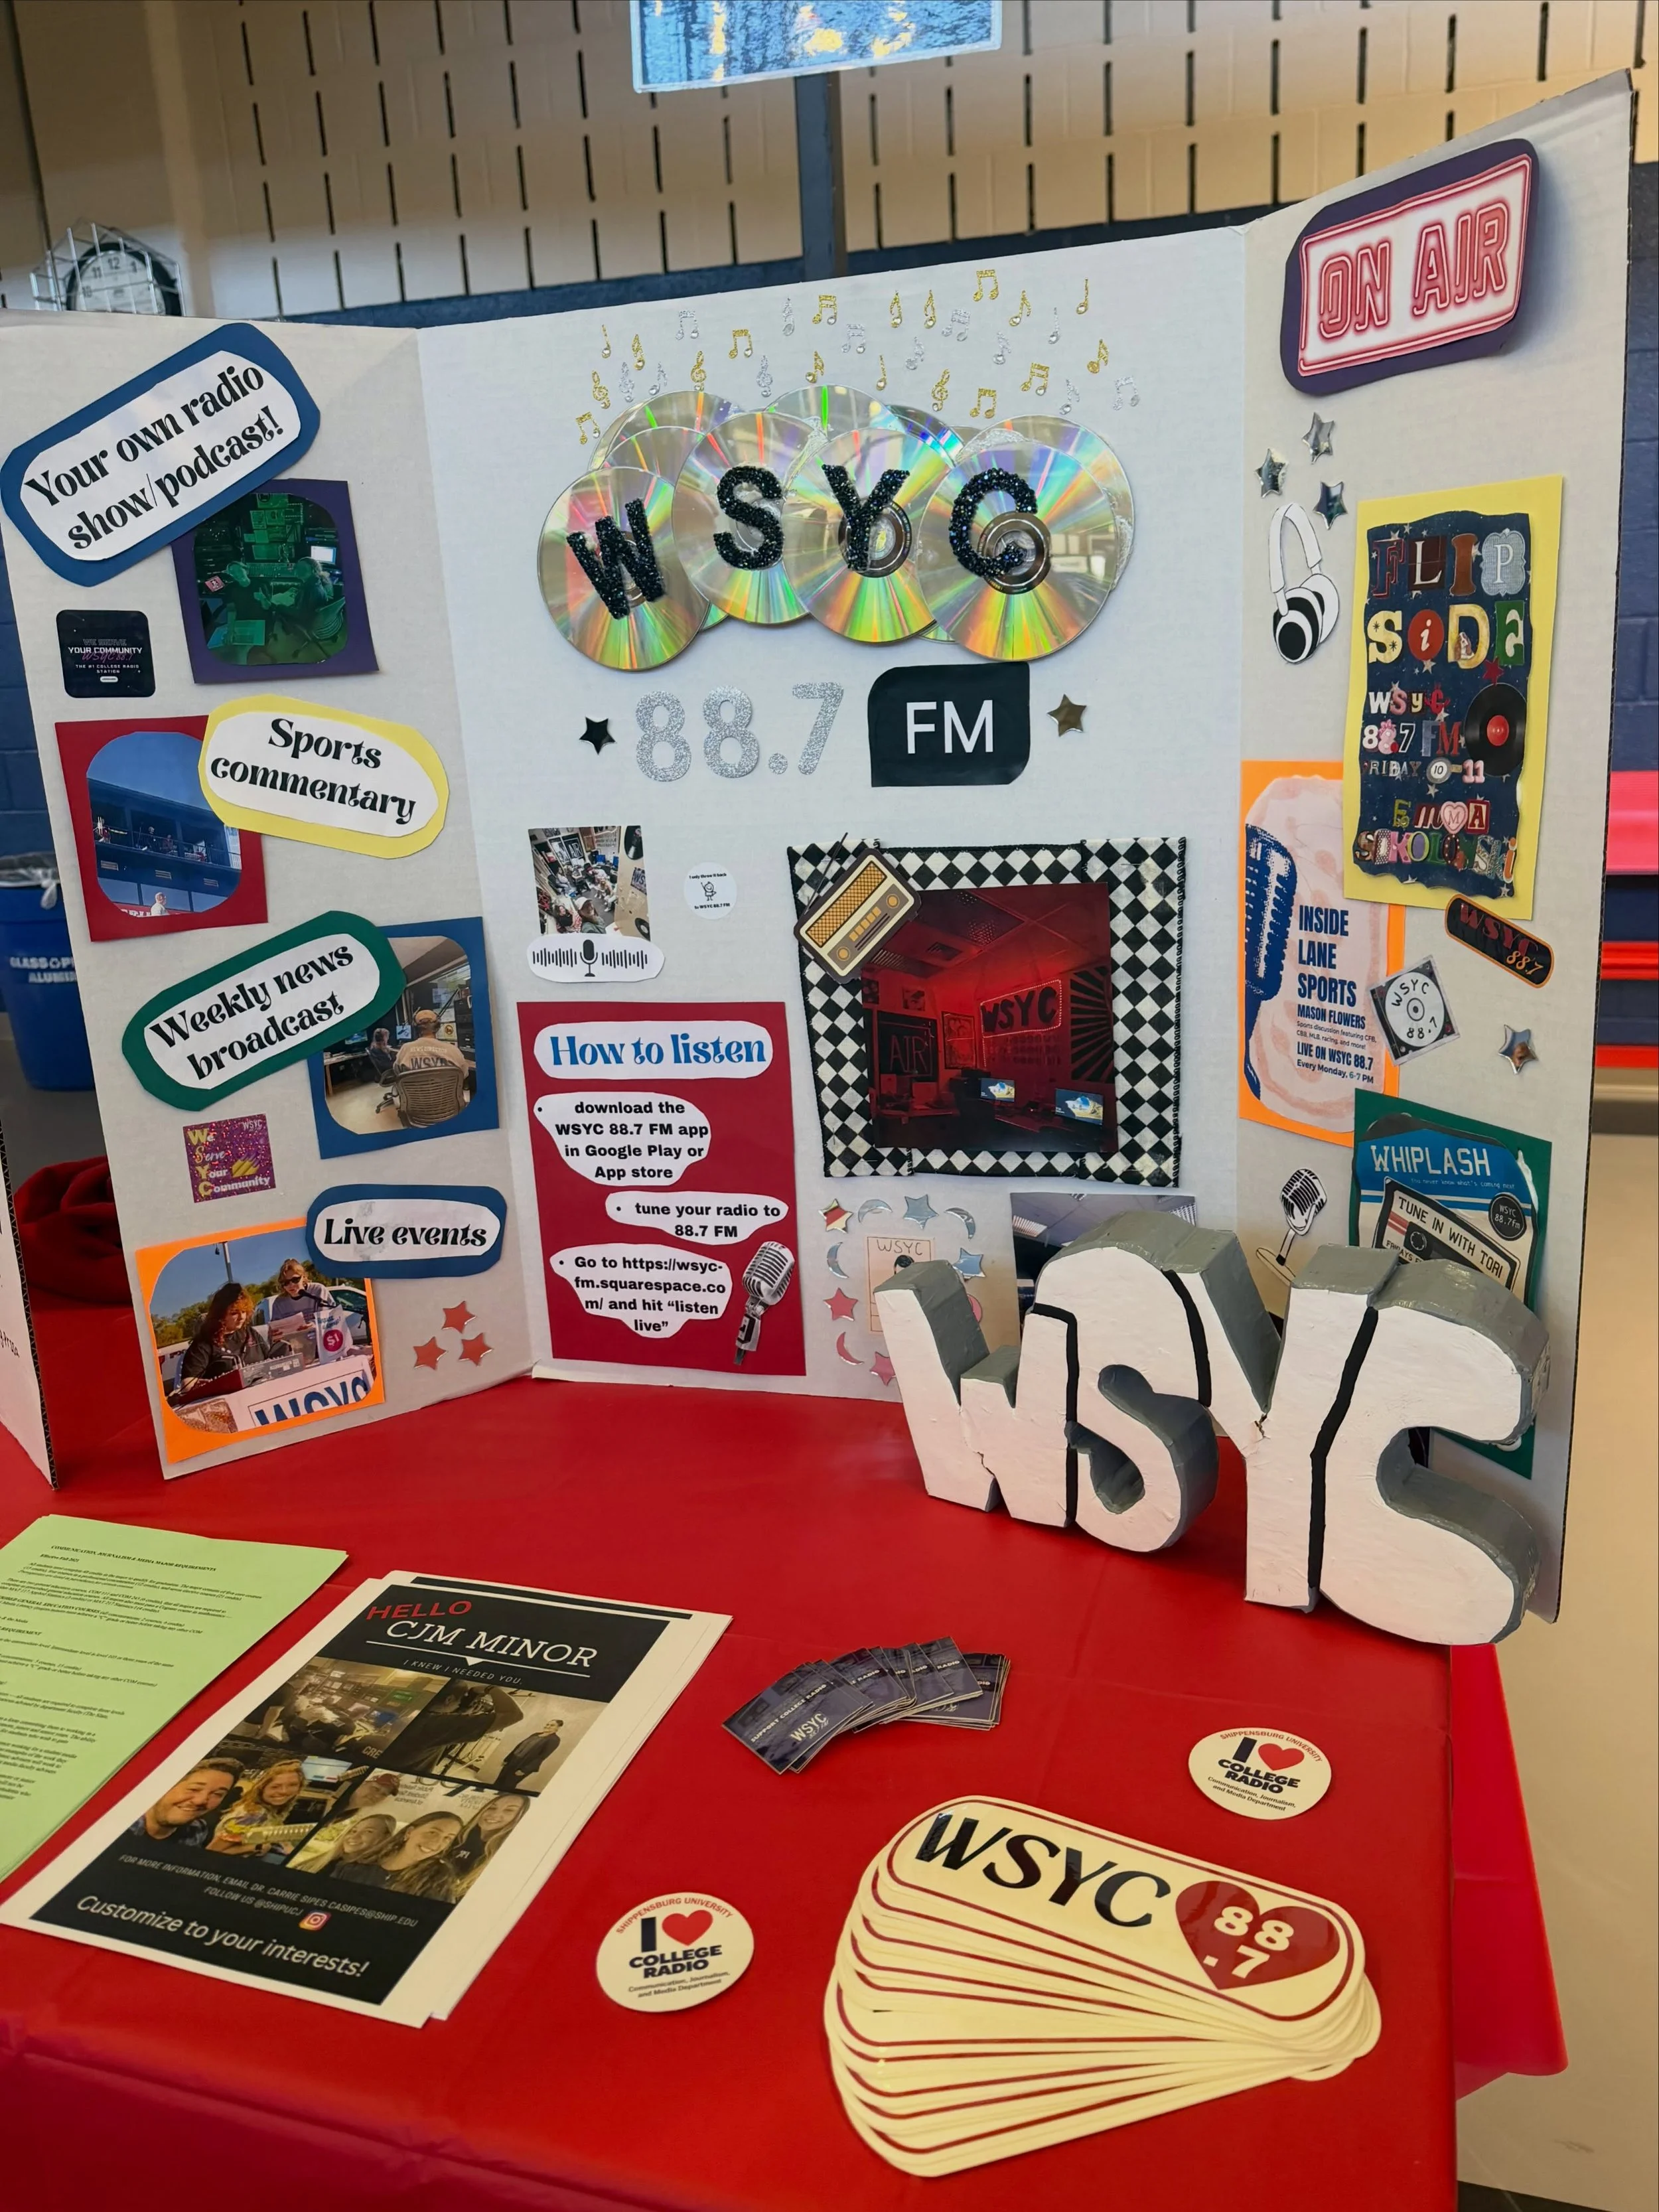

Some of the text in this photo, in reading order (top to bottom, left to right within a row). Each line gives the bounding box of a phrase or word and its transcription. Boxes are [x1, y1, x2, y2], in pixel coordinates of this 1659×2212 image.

[108, 258, 120, 269] 12
[1318, 202, 1509, 340] ON AIR
[25, 365, 264, 507] Your own radio
[68, 405, 284, 550] show/podcast!
[1372, 531, 1520, 599] FLIP
[268, 718, 382, 769] Sports
[634, 682, 995, 782] 88.7 FM
[210, 757, 416, 824] commentary
[1299, 905, 1348, 936] INSIDE
[1459, 903, 1538, 956] WSYC
[1299, 939, 1336, 969] LANE
[1506, 950, 1544, 976] 88.7
[149, 946, 354, 1049] Weekly news
[1297, 972, 1356, 1007] SPORTS
[1391, 979, 1429, 1007] WSYC
[981, 986, 1056, 1033] WSYC
[1297, 1004, 1366, 1029] MASON FLOWERS
[186, 992, 344, 1080] broadcast
[1314, 1024, 1340, 1035] discussion
[1340, 1029, 1364, 1041] featuring
[1406, 1016, 1437, 1039] 88.7
[550, 1033, 766, 1066] How to listen
[1297, 1041, 1374, 1070] LIVE ON WSYC 88.7
[1297, 1059, 1374, 1083] Every Monday, 6-7 PM
[575, 1101, 685, 1114] download the
[187, 1128, 215, 1145] We
[242, 1120, 262, 1130] WSYC
[555, 1124, 709, 1139] WSYC 88.7 FM app
[195, 1146, 225, 1163] Serve
[564, 1144, 703, 1160] in Google Play or
[1370, 1145, 1490, 1176] WHIPLASH
[195, 1164, 228, 1179] Your
[595, 1166, 673, 1181] App store
[198, 1177, 270, 1197] Community
[635, 1204, 780, 1220] tune your radio to
[1494, 1213, 1520, 1229] 88.7fm
[1499, 1205, 1516, 1217] WSYC
[323, 1218, 487, 1248] Live events
[675, 1225, 737, 1237] 88.7 FM
[1399, 1196, 1503, 1278] TUNE IN WITH TORI
[876, 1239, 923, 1256] WSYC
[575, 1256, 723, 1274] Go to https://wsyc-
[575, 1277, 725, 1294] fm.squarespace.co
[585, 1297, 603, 1311] m/
[609, 1299, 638, 1311] and
[642, 1299, 664, 1311] hit
[327, 1335, 340, 1346] $1
[873, 1211, 1550, 1645] WSYC
[366, 1600, 472, 1620] HELLO
[386, 1620, 598, 1667] CJM MINOR
[411, 1660, 522, 1684] KNEW NEEDED YOU.
[857, 1669, 881, 1682] RADIO
[937, 1660, 960, 1669] RADIO
[751, 1684, 827, 1743] SUPPORT COLLEGE RADIO
[790, 1713, 827, 1741] WSYC
[1220, 1730, 1323, 1762] SHIPPENSBURG UNIVERSITY
[1232, 1736, 1258, 1763] I
[1218, 1759, 1301, 1788] COLLEGE
[1224, 1770, 1283, 1794] RADIO
[1208, 1776, 1296, 1808] Communication, Journalism,
[1226, 1789, 1246, 1800] Media
[1247, 1795, 1286, 1811] Department
[914, 1811, 1171, 1929] WSYC
[119, 1854, 138, 1863] FOR
[137, 1858, 165, 1870] MORE
[222, 1877, 250, 1889] EMAIL
[250, 1883, 265, 1893] DR.
[267, 1887, 300, 1901] CARRIE
[301, 1895, 328, 1907] SIPES
[328, 1901, 419, 1927] CASIPES@SHIP.EDU
[204, 1886, 304, 1916] FOLLOW US @SHIPUCJ
[616, 1897, 733, 1934] SHIPPENSBURG UNIVERSITY
[76, 1895, 370, 1977] Customize to your interests!
[641, 1917, 656, 1953] I
[629, 1945, 723, 1968] COLLEGE
[643, 1959, 709, 1978] RADIO
[654, 1987, 677, 1996] Media
[678, 1978, 722, 1992] Department
